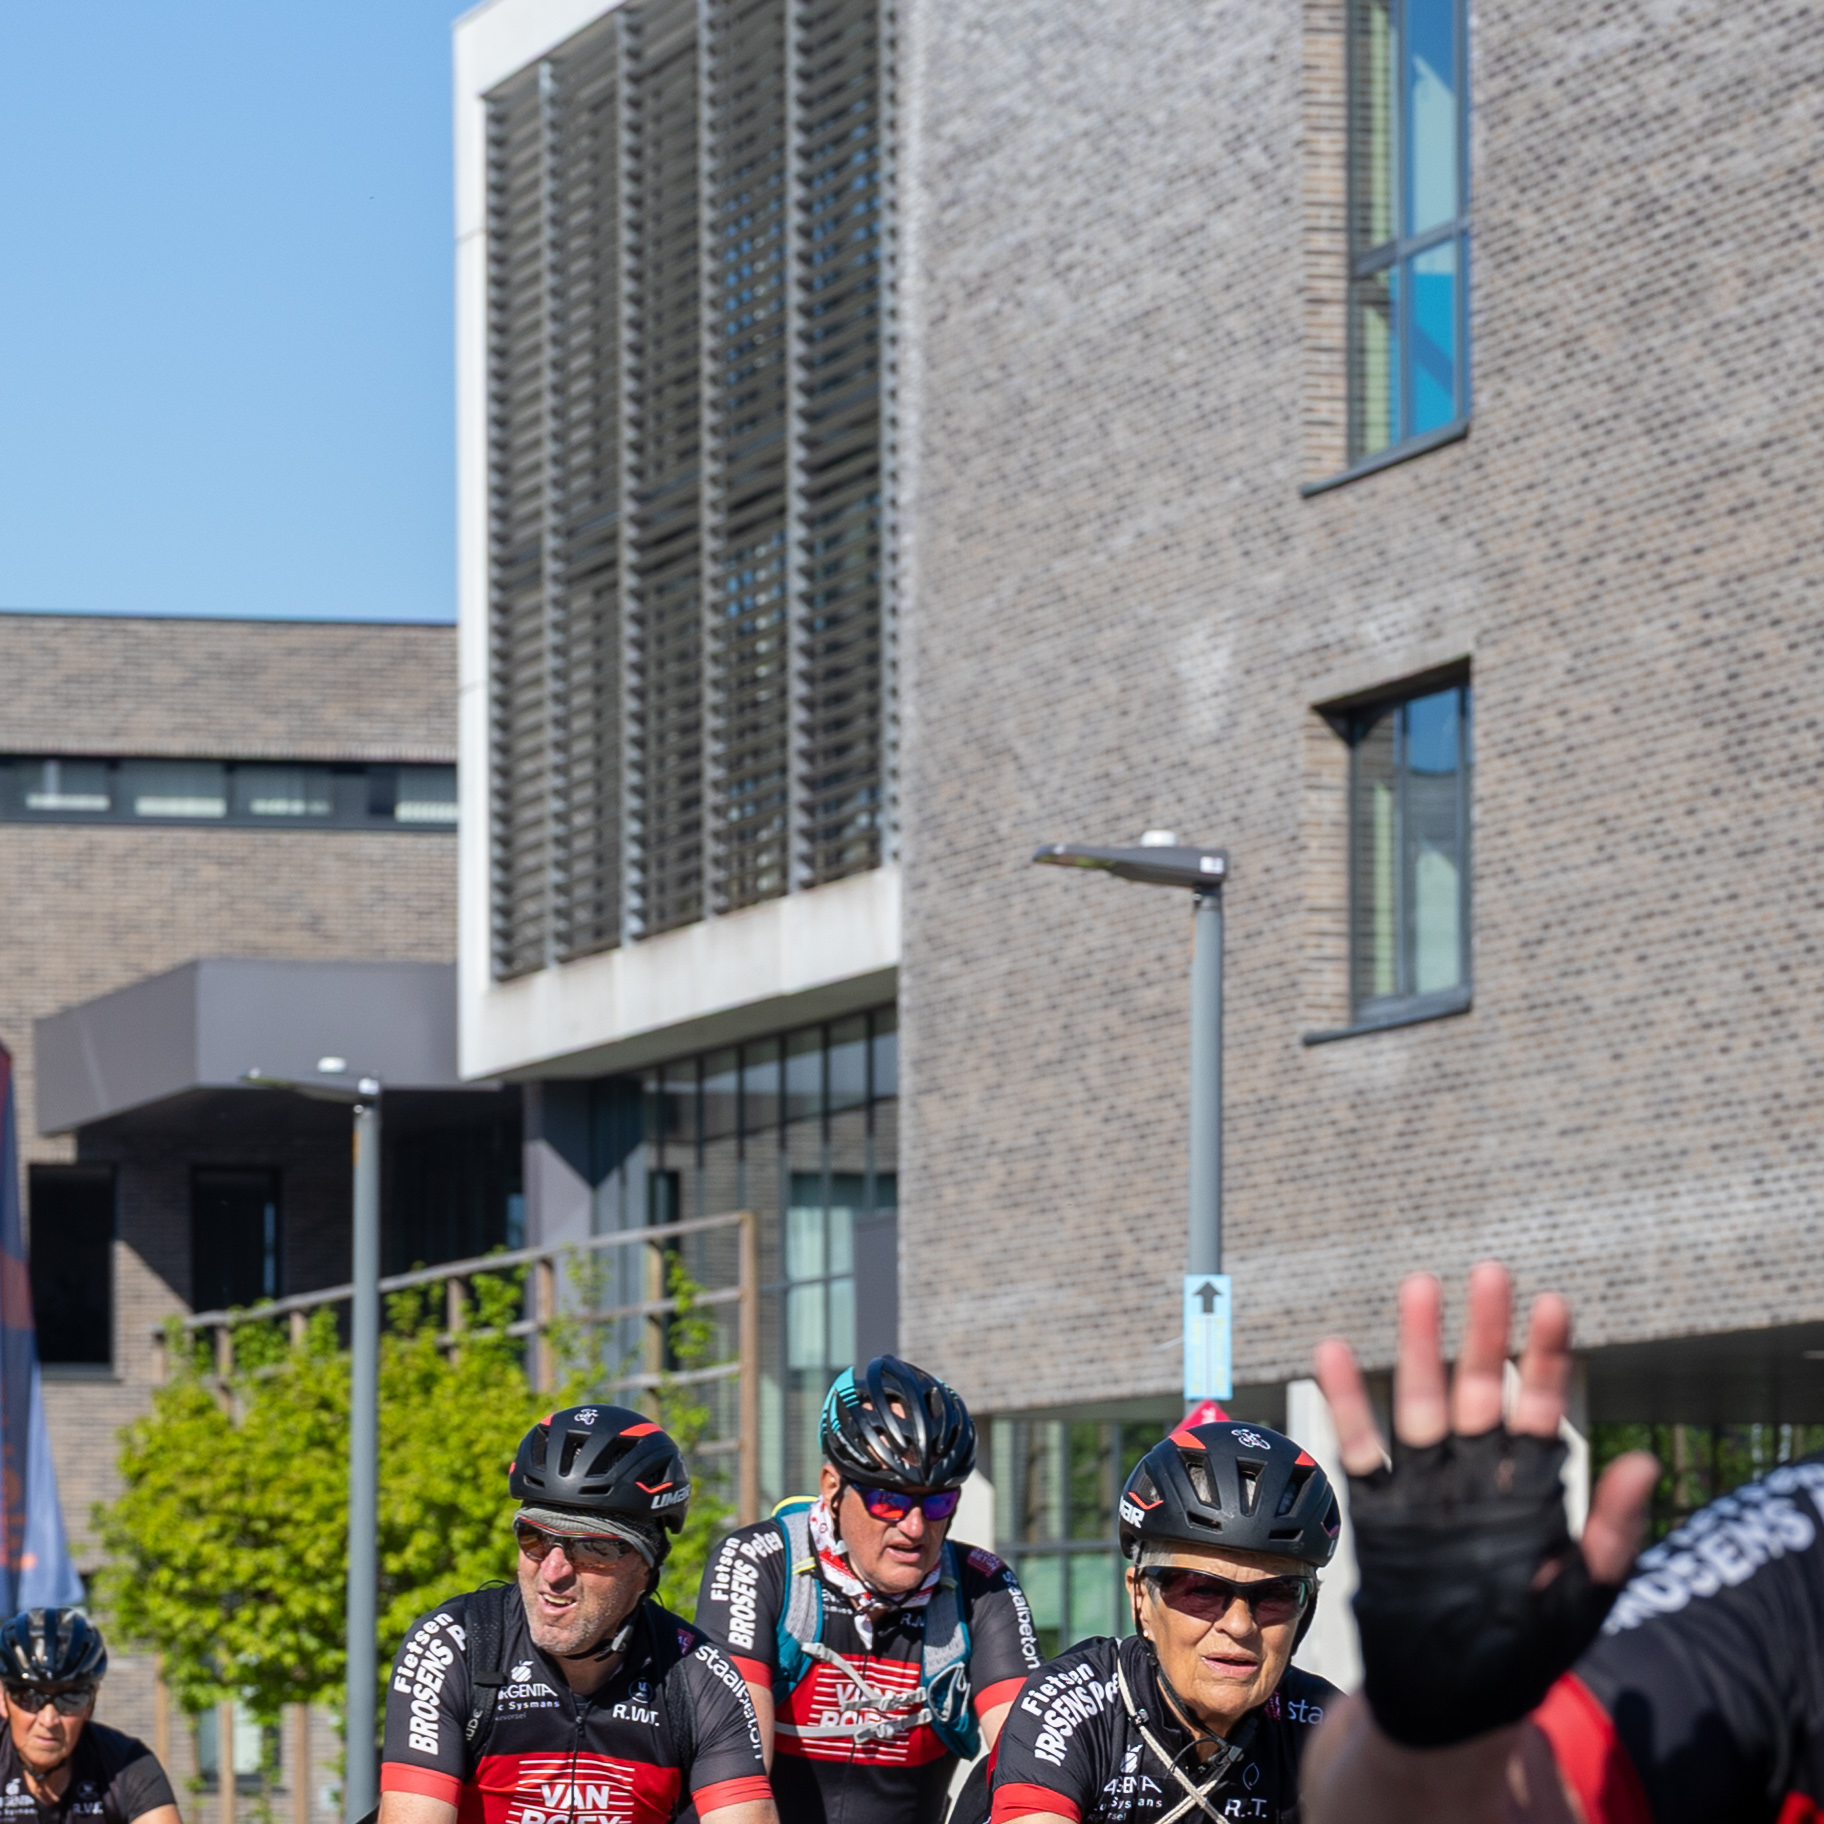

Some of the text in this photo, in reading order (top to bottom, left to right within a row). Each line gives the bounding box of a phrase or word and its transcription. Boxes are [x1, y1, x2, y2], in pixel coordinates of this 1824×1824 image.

[394, 1612, 454, 1695] Fietsen
[408, 1638, 454, 1757] BROSENS
[1021, 1662, 1095, 1717] Fietsen
[540, 1784, 610, 1811] VAN
